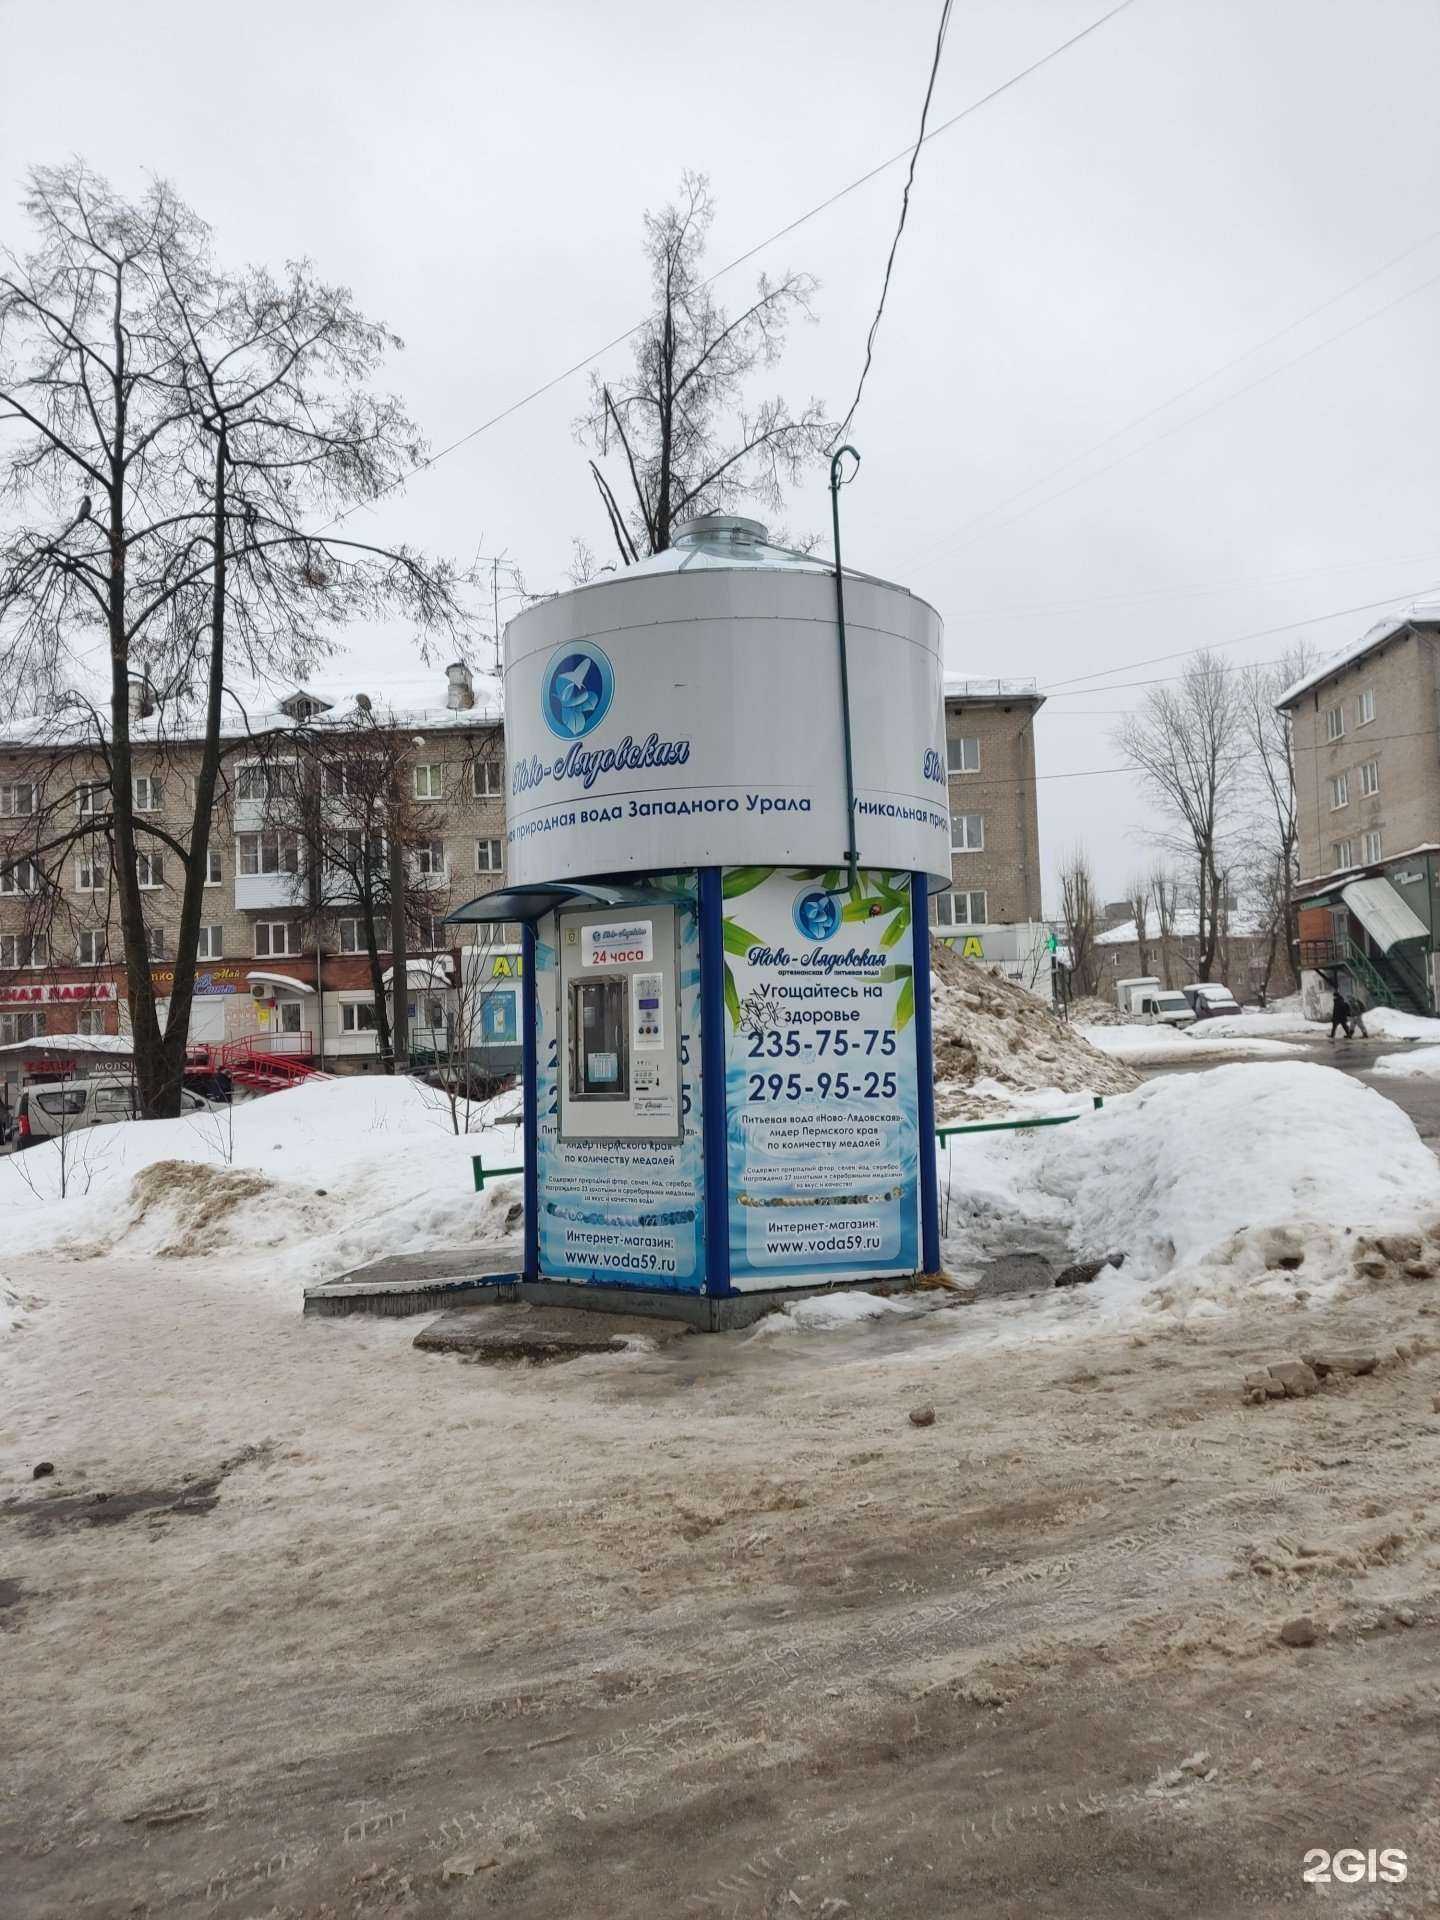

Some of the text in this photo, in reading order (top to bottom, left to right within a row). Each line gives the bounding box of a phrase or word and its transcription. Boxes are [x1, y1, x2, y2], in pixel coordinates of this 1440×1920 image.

[516, 812, 576, 840] природная
[580, 806, 622, 823] вода
[629, 796, 739, 817] Западного
[746, 795, 812, 813] Урала
[592, 950, 644, 965] 24 часа
[760, 983, 883, 1000] Угощайтесь на
[784, 1009, 860, 1025] здоровье
[748, 1029, 896, 1059] 235-75-75
[749, 1071, 897, 1101] 295-95-25
[742, 1114, 787, 1125] Питьевая
[790, 1114, 813, 1125] вода
[769, 1126, 878, 1138] лидер Пермского края
[767, 1138, 881, 1151] по количеству медалей
[578, 1155, 630, 1166] количеству
[632, 1155, 675, 1166] медалей
[768, 1220, 879, 1234] Интернет-магазин:
[566, 1230, 674, 1249] Интернет-магазин:
[767, 1235, 880, 1253] www.voda59.ru
[565, 1251, 676, 1271] www.voda59.ru
